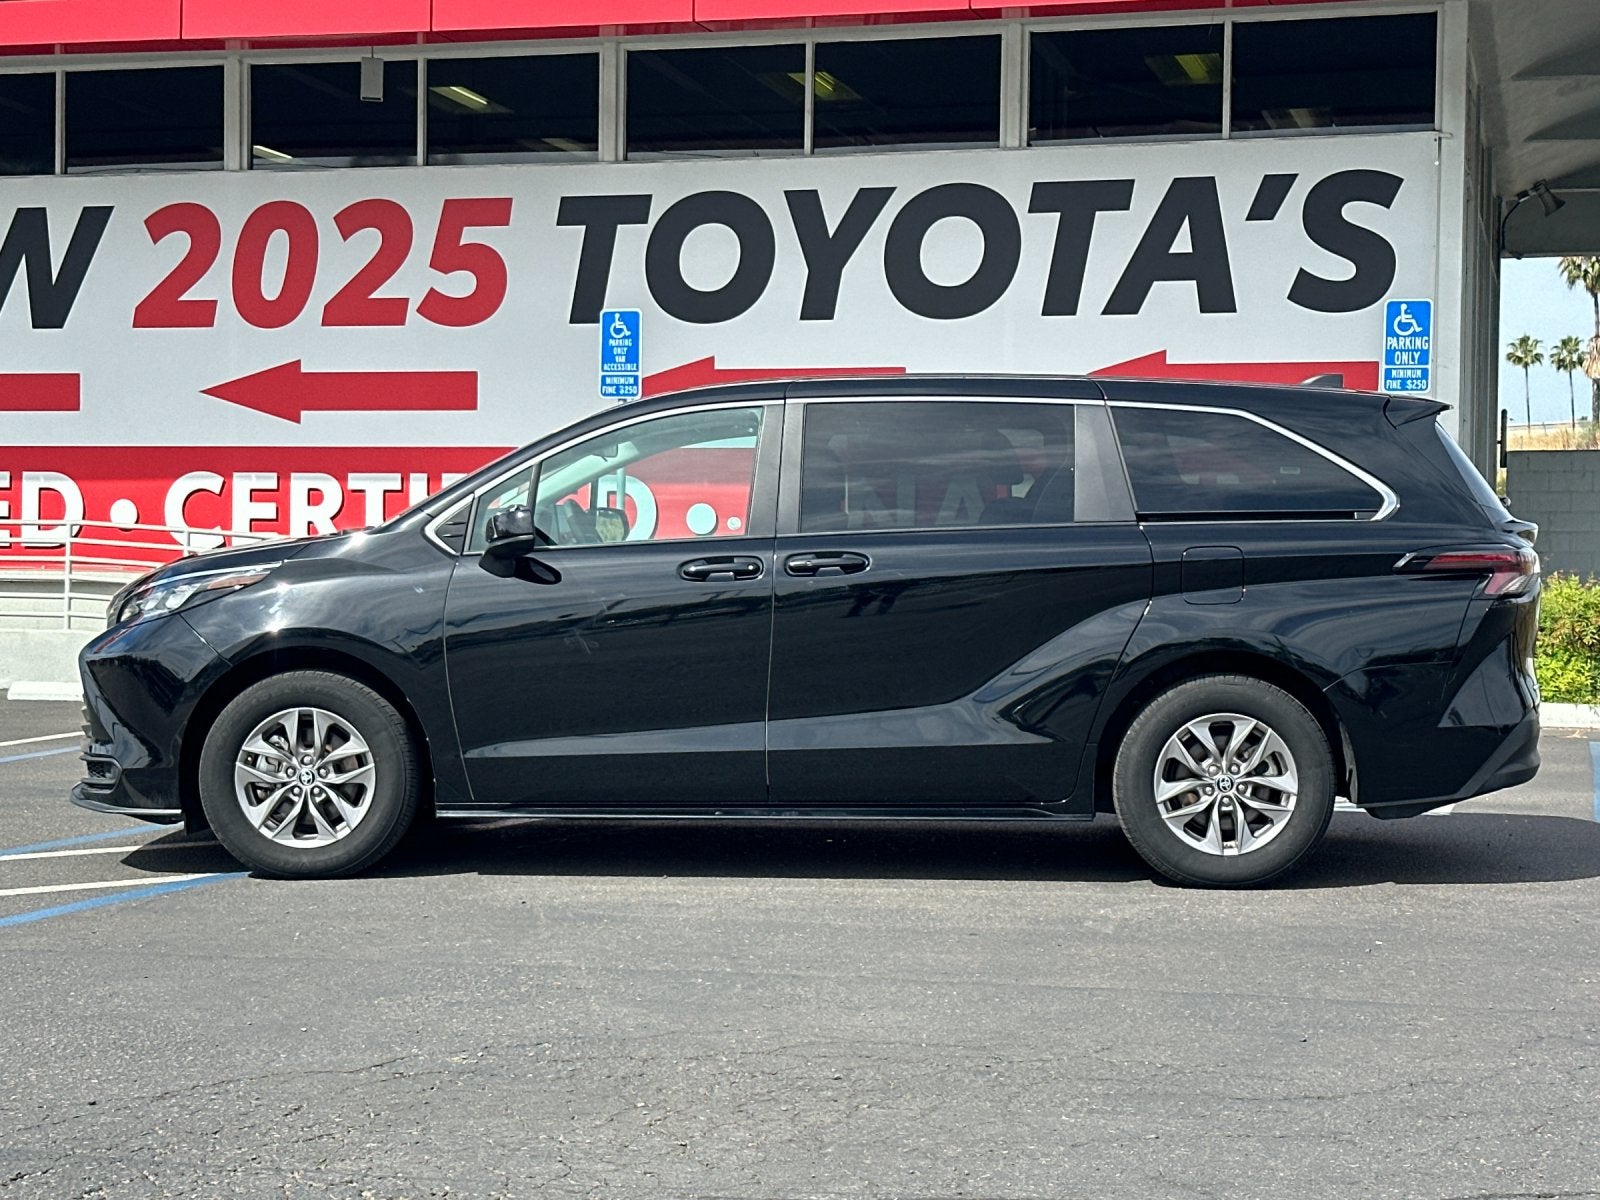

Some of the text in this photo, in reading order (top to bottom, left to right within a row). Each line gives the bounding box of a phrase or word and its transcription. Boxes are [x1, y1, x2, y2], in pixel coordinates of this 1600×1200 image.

[132, 197, 513, 329] 2025
[557, 169, 1404, 324] TOYOTA'S
[1387, 336, 1428, 350] PARKING
[1395, 351, 1420, 364] ONLY
[1391, 369, 1422, 378] MINIMUM
[605, 376, 634, 384] MINIMUM
[1386, 380, 1427, 389] FINE $250
[602, 385, 616, 394] FINE
